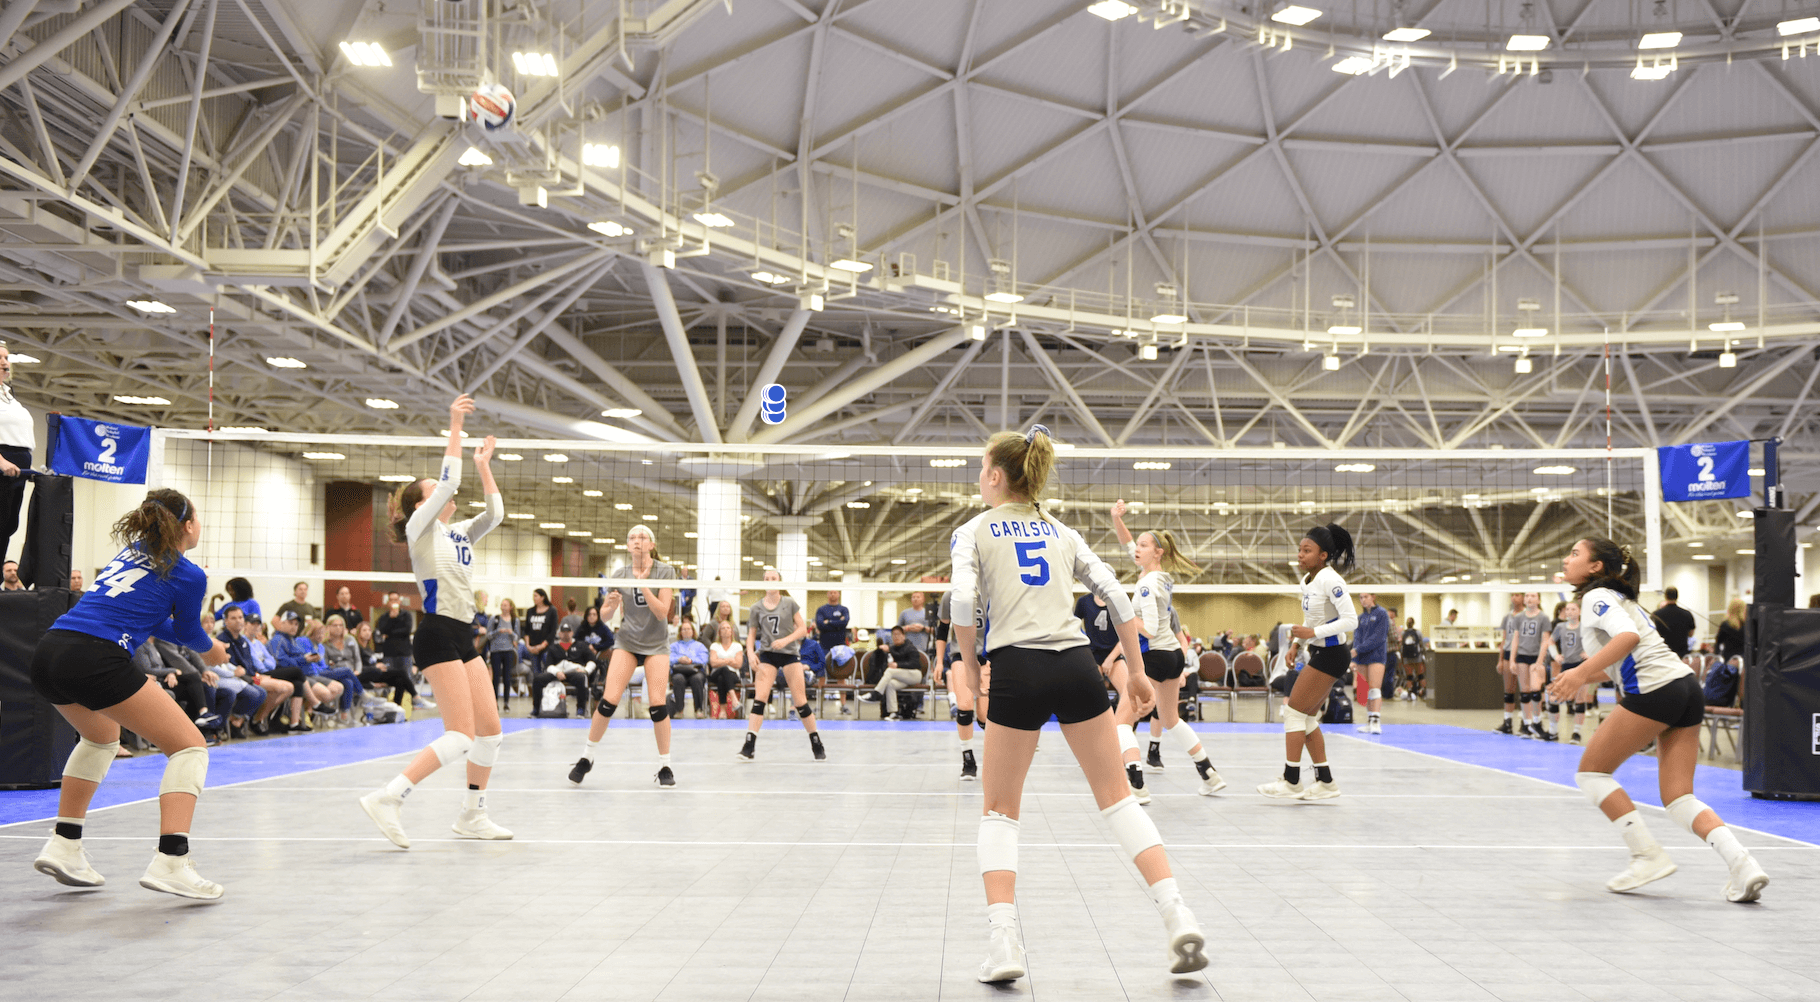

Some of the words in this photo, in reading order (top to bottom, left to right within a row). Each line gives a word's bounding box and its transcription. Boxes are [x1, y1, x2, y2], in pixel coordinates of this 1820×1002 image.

[98, 437, 117, 464] 2
[83, 461, 124, 475] molten
[1697, 456, 1715, 481] 2
[1687, 480, 1726, 492] molten
[990, 520, 1059, 539] CARLSON
[455, 545, 472, 566] 10
[1013, 540, 1051, 588] 5
[87, 561, 149, 598] 24
[767, 614, 780, 635] 7
[1094, 610, 1108, 631] 4
[1522, 621, 1538, 636] 19
[1566, 631, 1577, 648] 3
